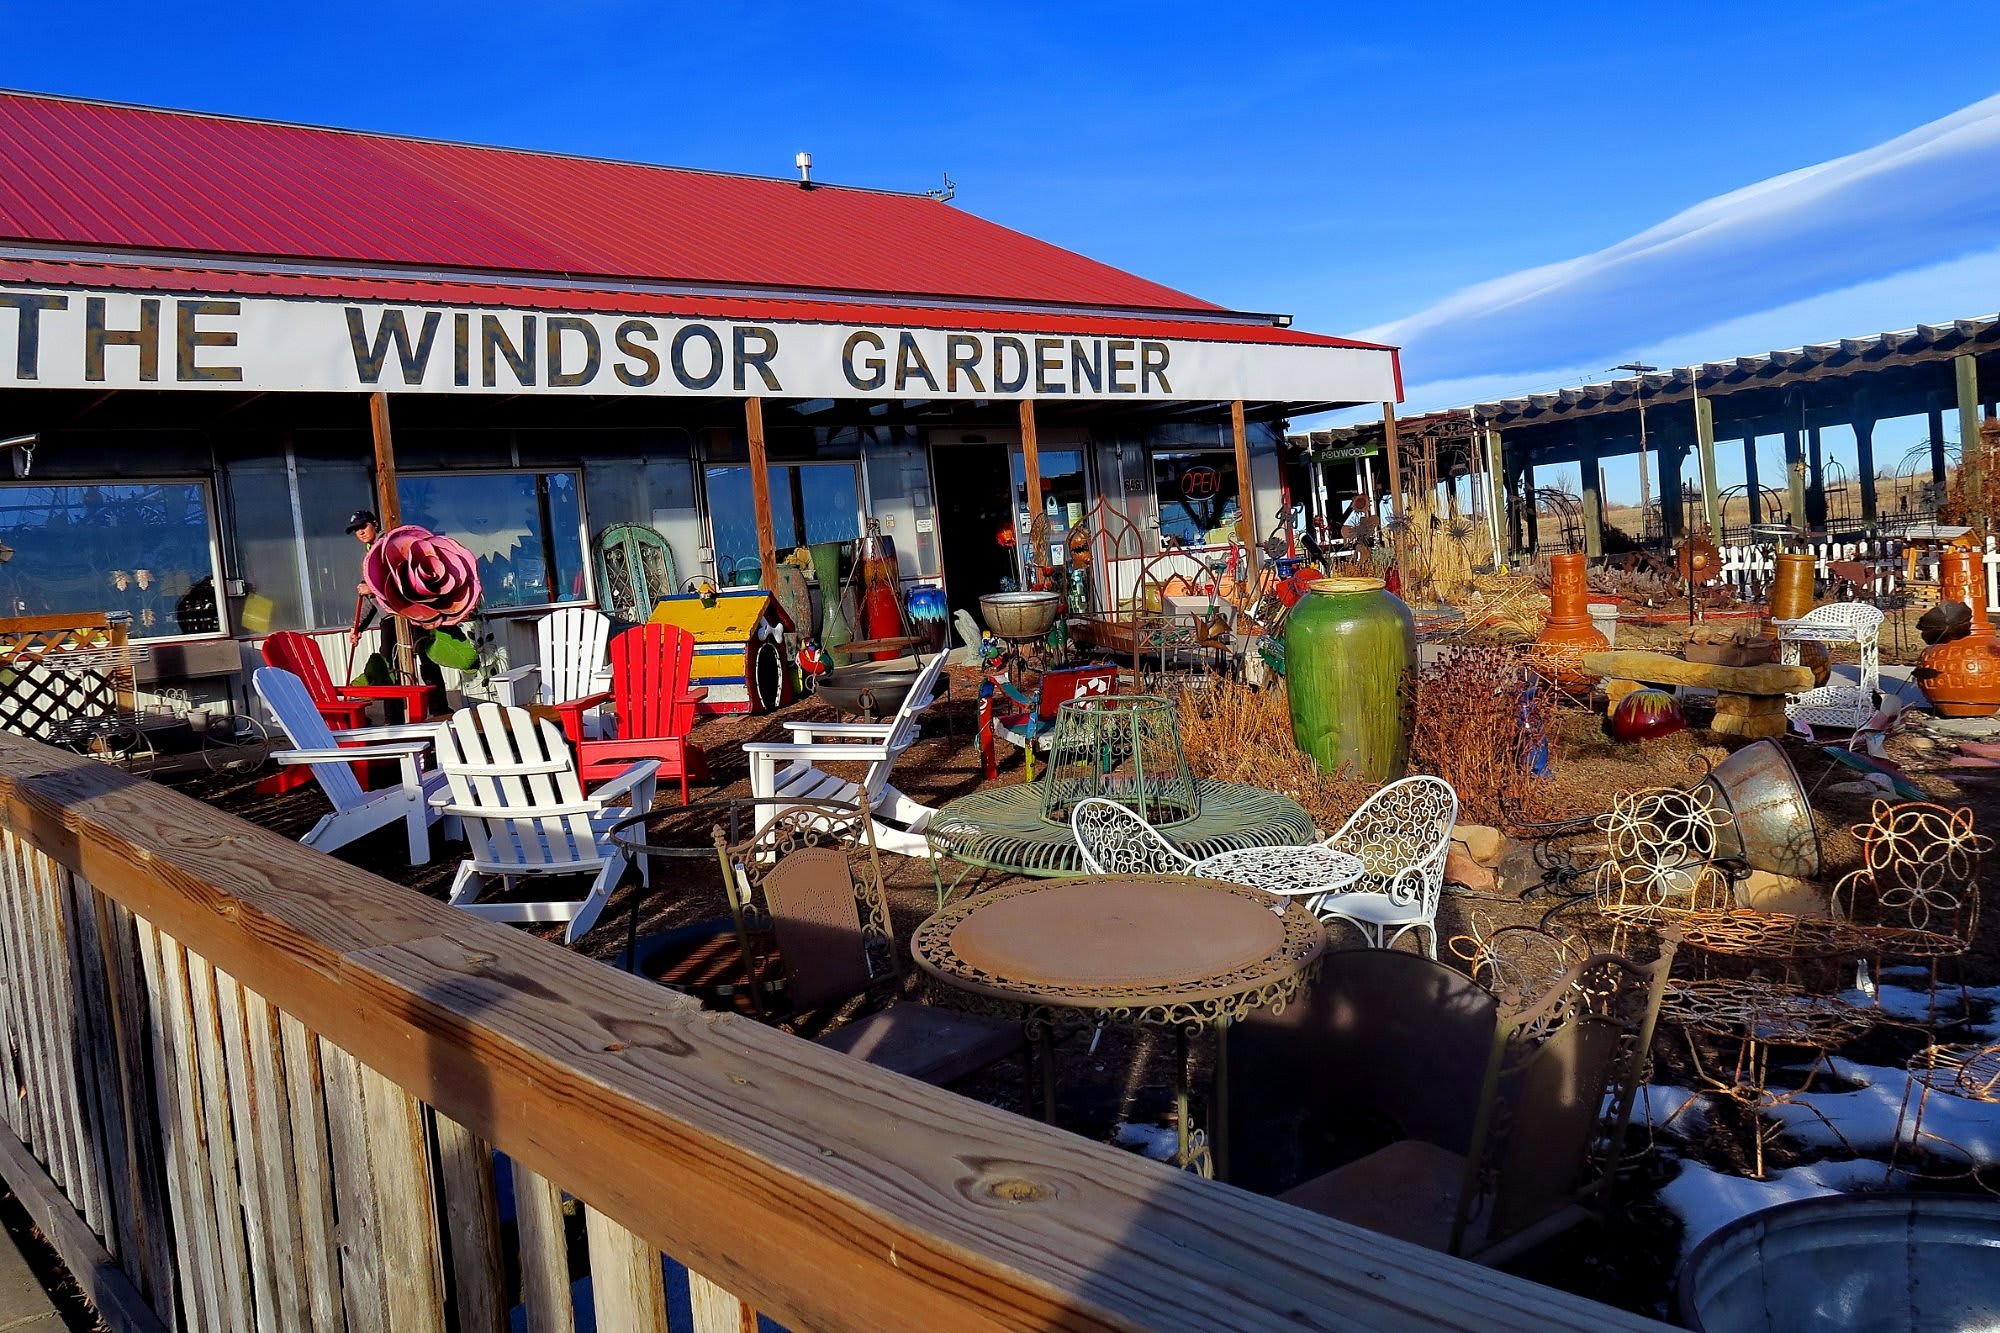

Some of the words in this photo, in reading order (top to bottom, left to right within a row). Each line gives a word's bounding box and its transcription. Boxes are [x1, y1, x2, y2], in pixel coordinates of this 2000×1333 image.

[0, 292, 243, 382] THE
[344, 307, 783, 392] WINDSOR
[841, 330, 1173, 394] GARDENER
[1321, 447, 1367, 460] POLYWOOD
[1181, 472, 1221, 494] OPEN
